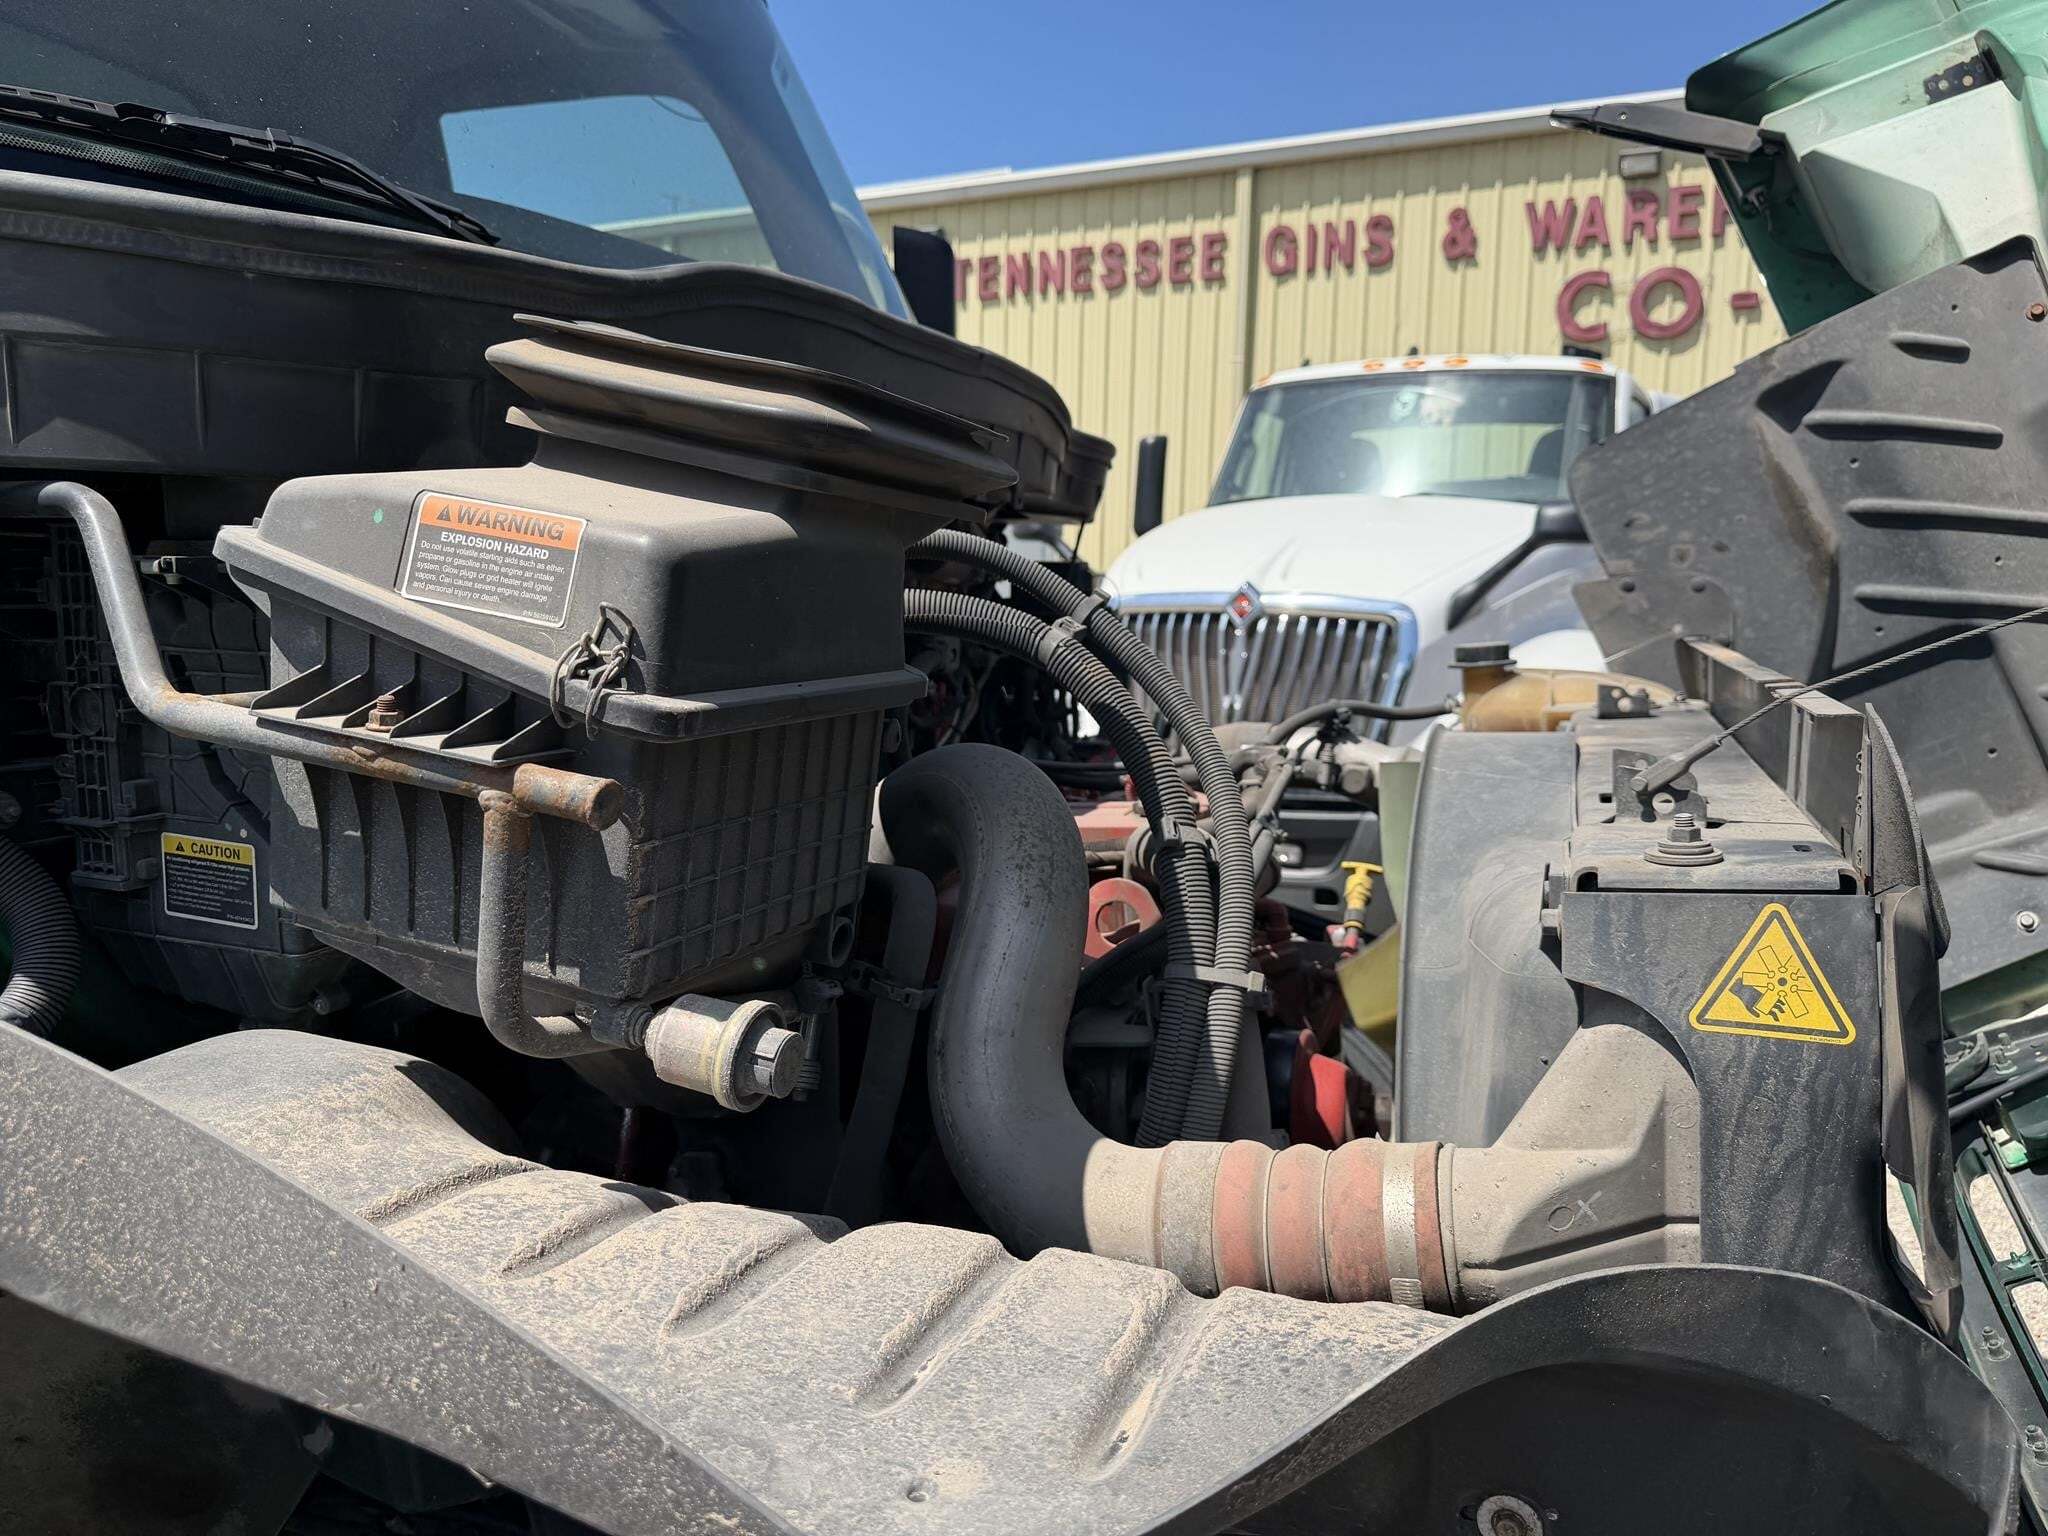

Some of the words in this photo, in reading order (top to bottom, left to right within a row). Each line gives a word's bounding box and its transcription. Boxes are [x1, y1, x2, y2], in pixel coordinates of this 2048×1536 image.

[955, 232, 1227, 302] TENNESSEE
[1265, 214, 1394, 276] GINS
[1442, 207, 1478, 260] &
[457, 504, 565, 541] WARNING
[421, 540, 430, 549] Do
[431, 543, 442, 551] not
[456, 547, 478, 557] volatile
[479, 551, 504, 564] starting
[504, 556, 519, 564] aids
[519, 559, 535, 568] such
[546, 564, 565, 574] ether,
[441, 531, 502, 551] EXPLOSION
[504, 543, 549, 560] HAZARD
[416, 561, 440, 571] system.
[442, 565, 458, 574] Glow
[460, 568, 477, 579] plugs
[486, 575, 500, 584] grid
[500, 576, 521, 586] heater
[522, 580, 534, 588] will
[535, 582, 553, 592] ignite
[418, 551, 445, 563] propane
[454, 557, 480, 569] gasoline
[489, 563, 500, 571] the
[501, 567, 522, 577] engine
[534, 572, 555, 582] intake
[413, 580, 425, 589] and
[425, 583, 454, 594] personal
[454, 588, 472, 598] injury
[480, 592, 500, 603] death.
[415, 571, 438, 581] vapors.
[440, 574, 453, 583] Can
[454, 578, 473, 587] cause
[474, 582, 496, 591] severe
[497, 587, 520, 597] engine
[520, 590, 548, 603] damage
[190, 842, 241, 861] CAUTION
